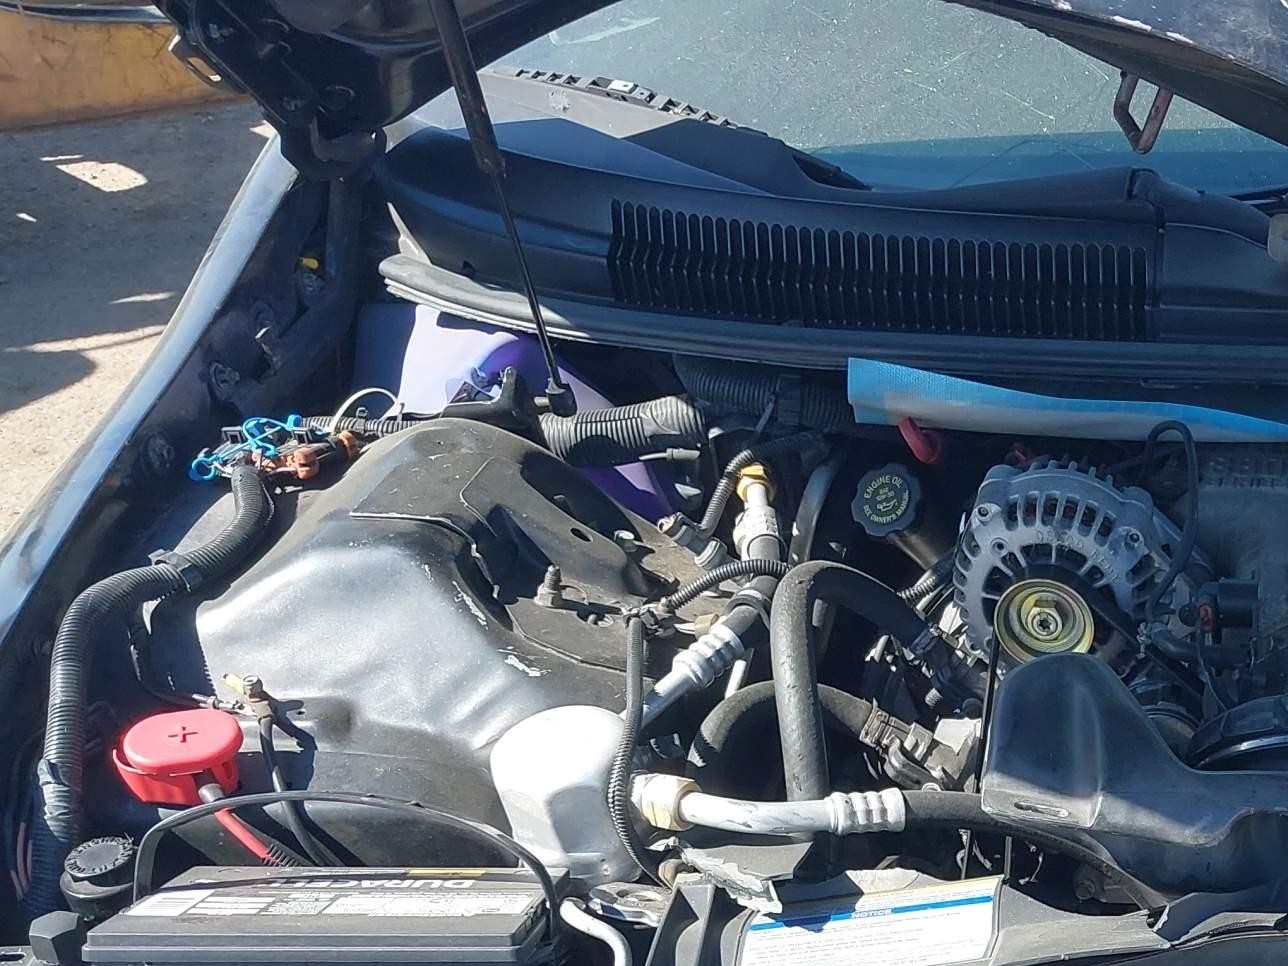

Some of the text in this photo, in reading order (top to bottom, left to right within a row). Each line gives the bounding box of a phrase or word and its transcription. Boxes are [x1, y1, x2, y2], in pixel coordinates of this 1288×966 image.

[863, 475, 904, 499] ENGINE OIL
[255, 878, 476, 890] DURACELL
[853, 907, 892, 919] NOTICE
